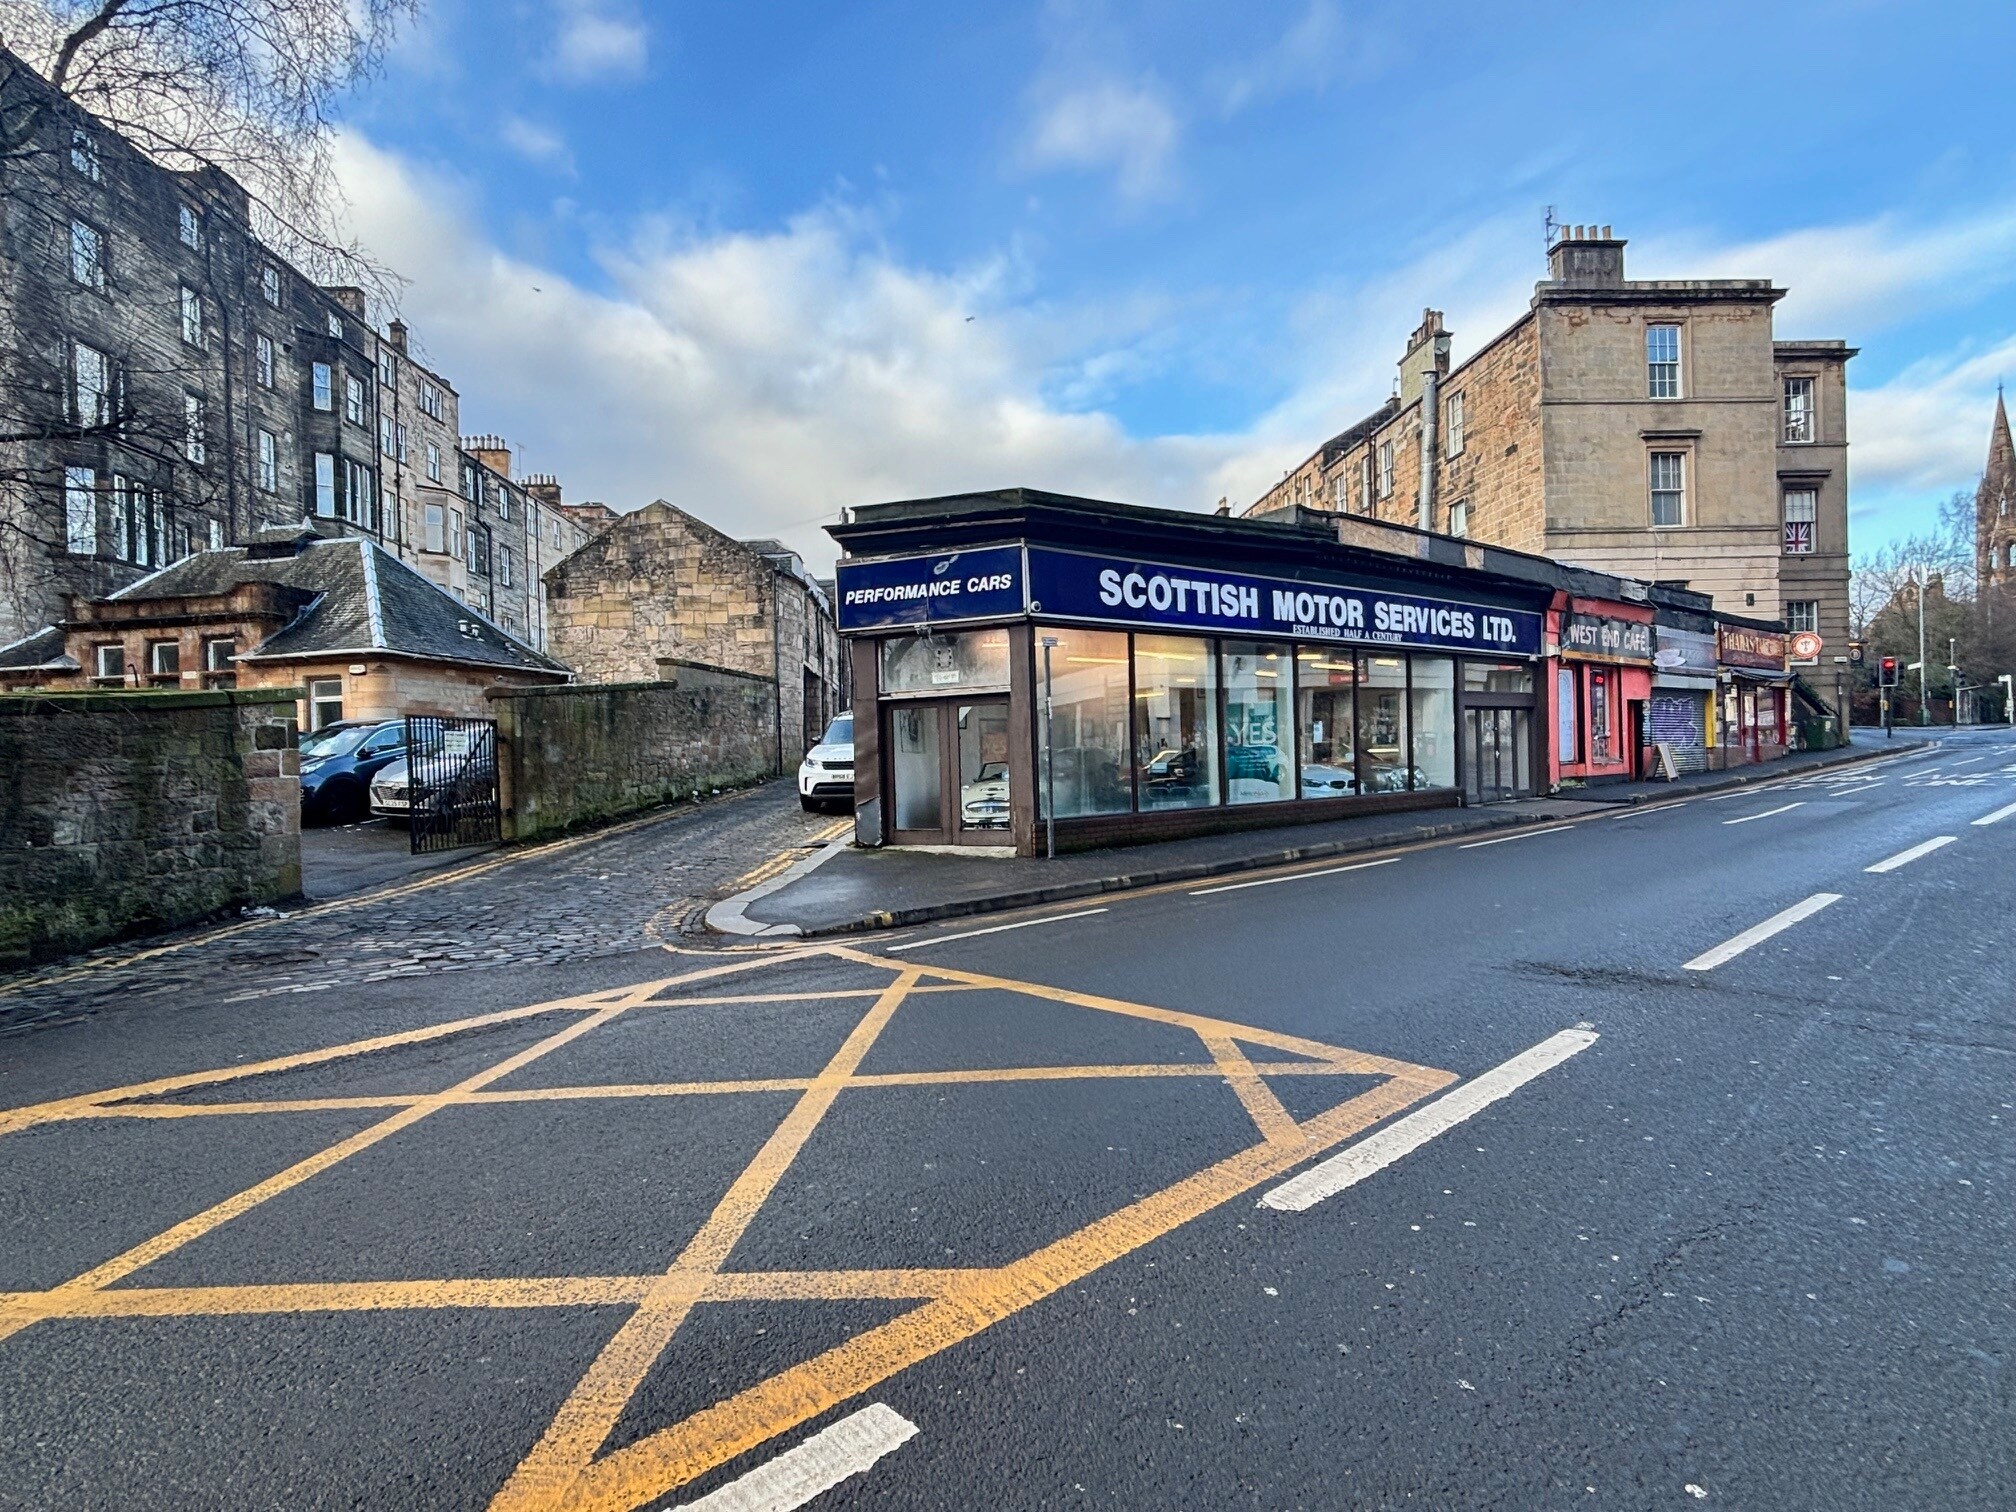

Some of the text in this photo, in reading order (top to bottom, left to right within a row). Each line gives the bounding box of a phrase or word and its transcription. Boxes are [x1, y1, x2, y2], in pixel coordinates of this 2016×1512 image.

[846, 574, 1012, 605] PERFORMANCE CARS
[1099, 569, 1517, 643] SCOTTISH MOTOR SERVICES LTD.
[1293, 624, 1403, 642] ESTABLISHED HALF A CENTURY
[1570, 624, 1598, 645] WEST
[1601, 628, 1620, 648] END
[1228, 721, 1277, 747] YES
